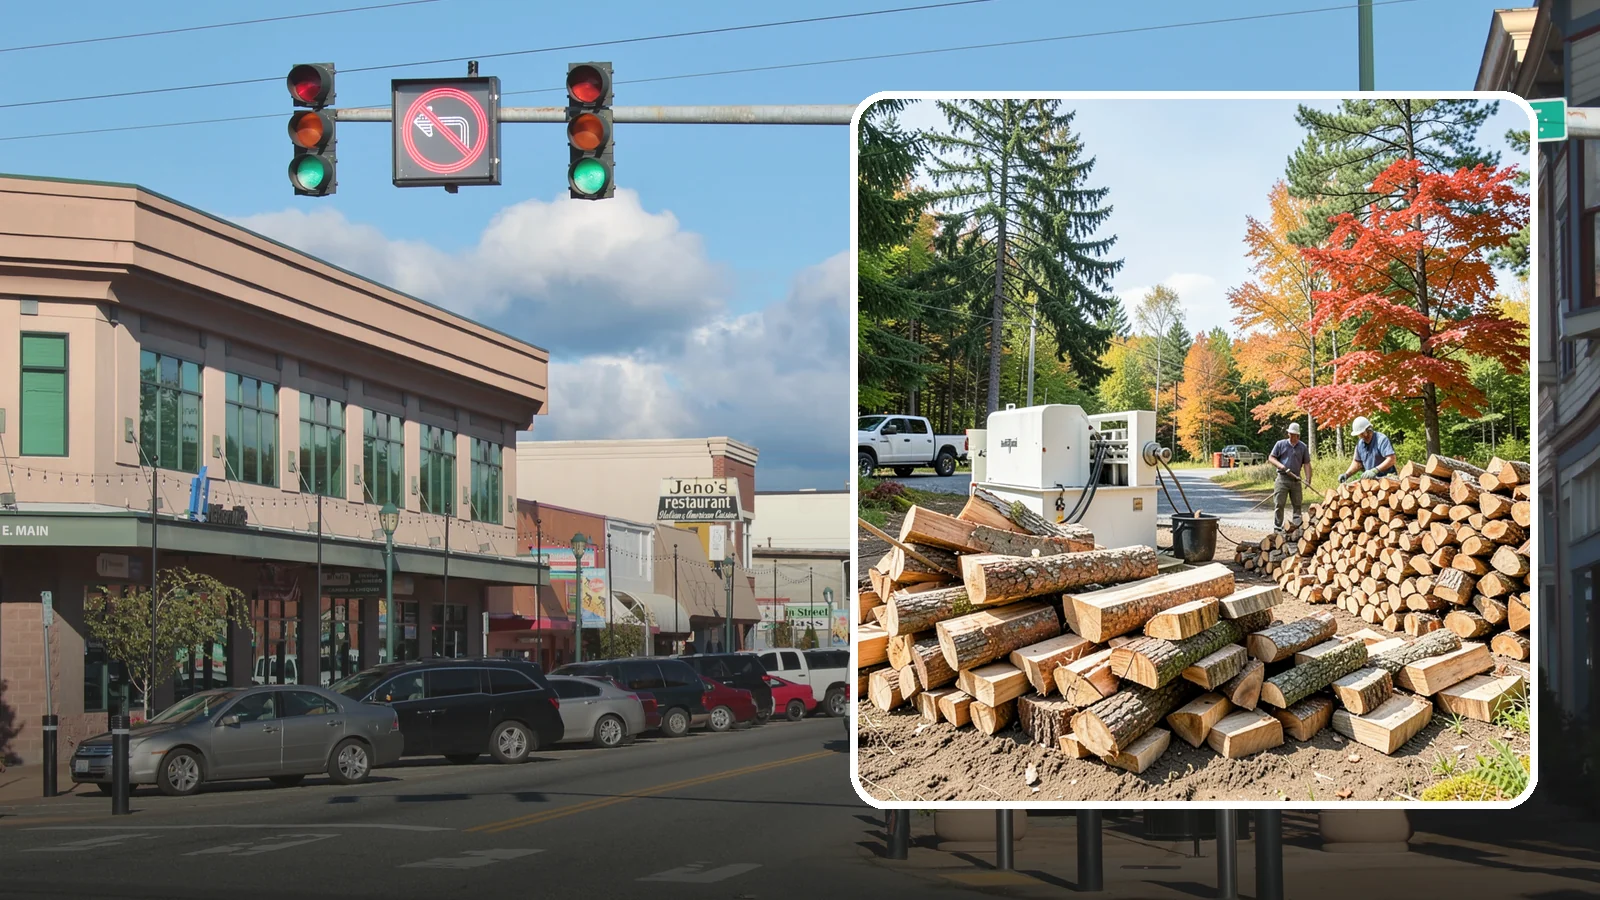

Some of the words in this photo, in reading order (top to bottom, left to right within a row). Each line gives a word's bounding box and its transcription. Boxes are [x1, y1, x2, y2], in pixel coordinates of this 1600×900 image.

[670, 480, 727, 494] Jeno's
[665, 497, 731, 509] restaurant
[686, 509, 714, 519] American
[715, 509, 737, 519] Cuisine
[2, 525, 12, 535] E.
[15, 525, 49, 536] MAIN
[797, 608, 828, 616] Street
